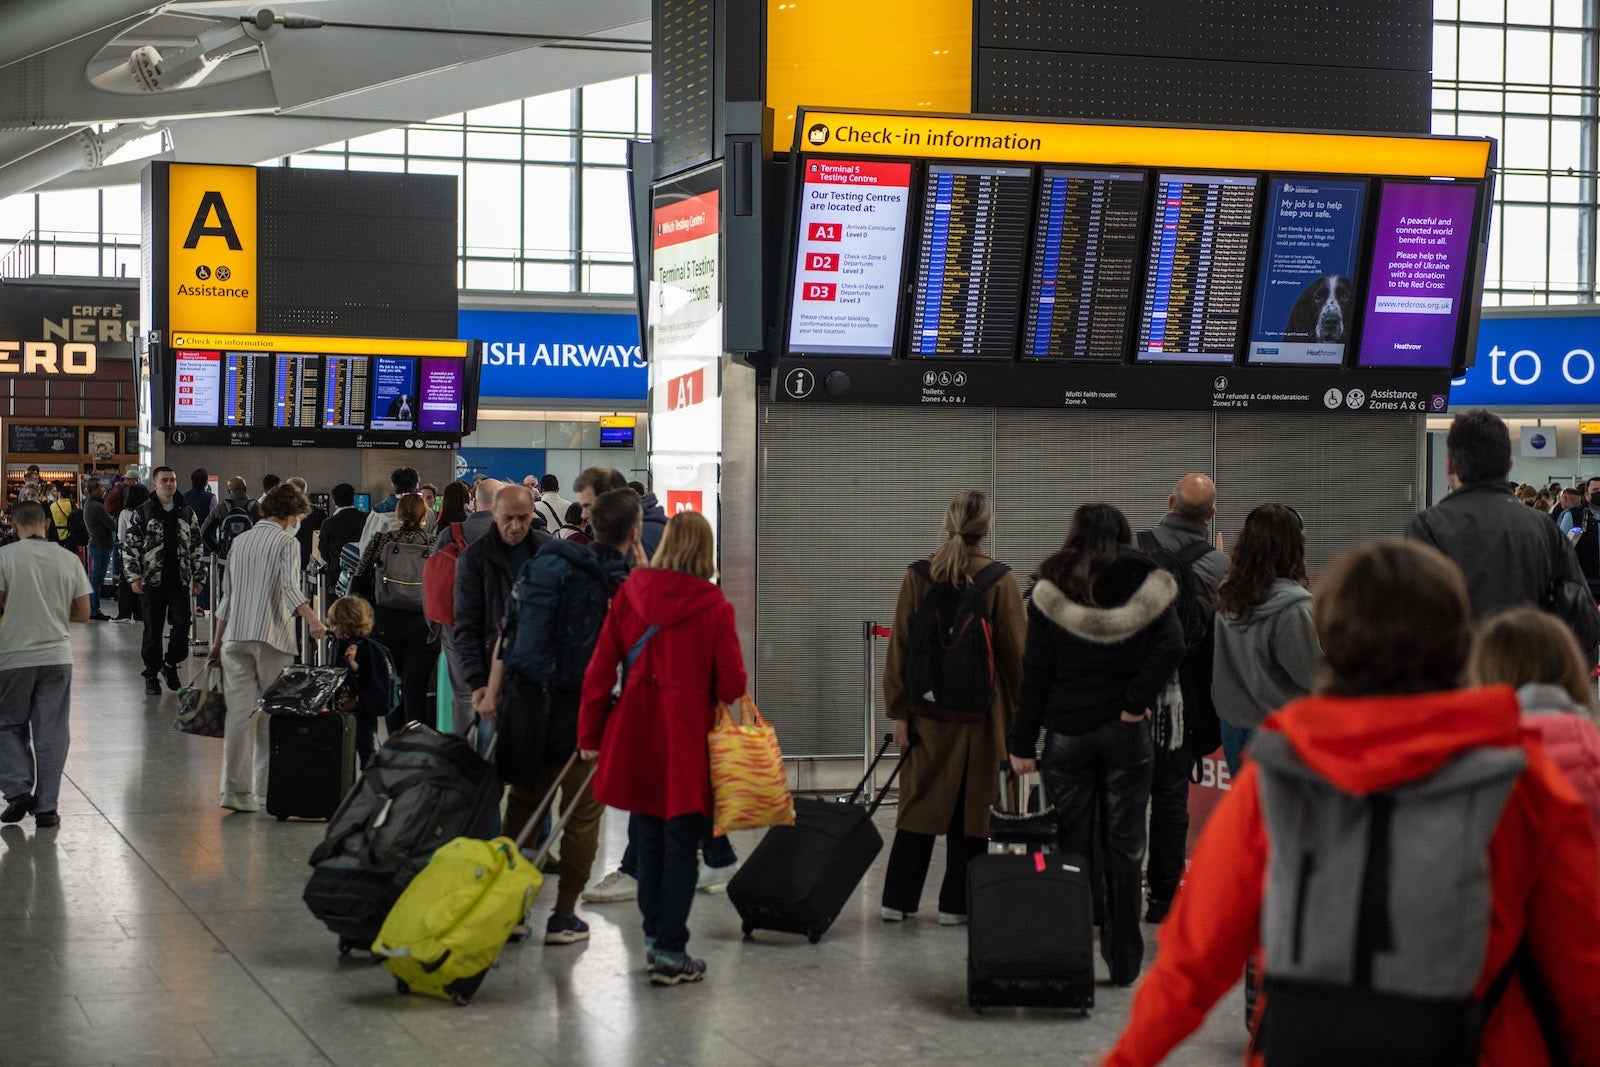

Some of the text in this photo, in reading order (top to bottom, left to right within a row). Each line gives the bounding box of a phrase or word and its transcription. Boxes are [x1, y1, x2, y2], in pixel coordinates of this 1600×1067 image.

[835, 126, 1042, 151] Check-in information
[820, 165, 854, 173] Terminal
[820, 173, 877, 183] Testing Centres
[811, 190, 901, 202] Our Testing Centres
[828, 202, 861, 212] located
[863, 204, 875, 212] at:
[1282, 200, 1294, 208] My
[1294, 200, 1306, 209] job
[1327, 202, 1342, 211] help
[1280, 209, 1297, 218] keep
[183, 191, 243, 251] A
[662, 212, 706, 234] Which Testing Centre?
[1407, 217, 1437, 226] peaceful
[815, 226, 835, 239] A1
[1396, 227, 1431, 235] connected
[1399, 236, 1426, 244] benefits
[1396, 251, 1418, 259] Please
[1419, 252, 1434, 261] help
[813, 256, 832, 268] D2
[1388, 262, 1413, 270] people
[1423, 262, 1450, 270] Ukraine
[659, 256, 715, 284] Terminal 5 Testing
[1391, 270, 1407, 278] with
[1414, 271, 1445, 279] donation
[1398, 280, 1409, 288] the
[1425, 281, 1445, 289] Cross:
[178, 284, 249, 299] Assistance
[810, 286, 829, 298] D3
[1377, 300, 1450, 310] www.redcross.org.uk
[72, 304, 123, 317] CAFFÈ
[186, 338, 222, 346] Check-in
[532, 343, 648, 368] AIRWAYS
[1488, 345, 1594, 385] to o
[676, 376, 693, 410] A1
[1256, 393, 1271, 401] Cash
[1370, 389, 1418, 399] Assistance
[1369, 400, 1426, 410] Zones A & G
